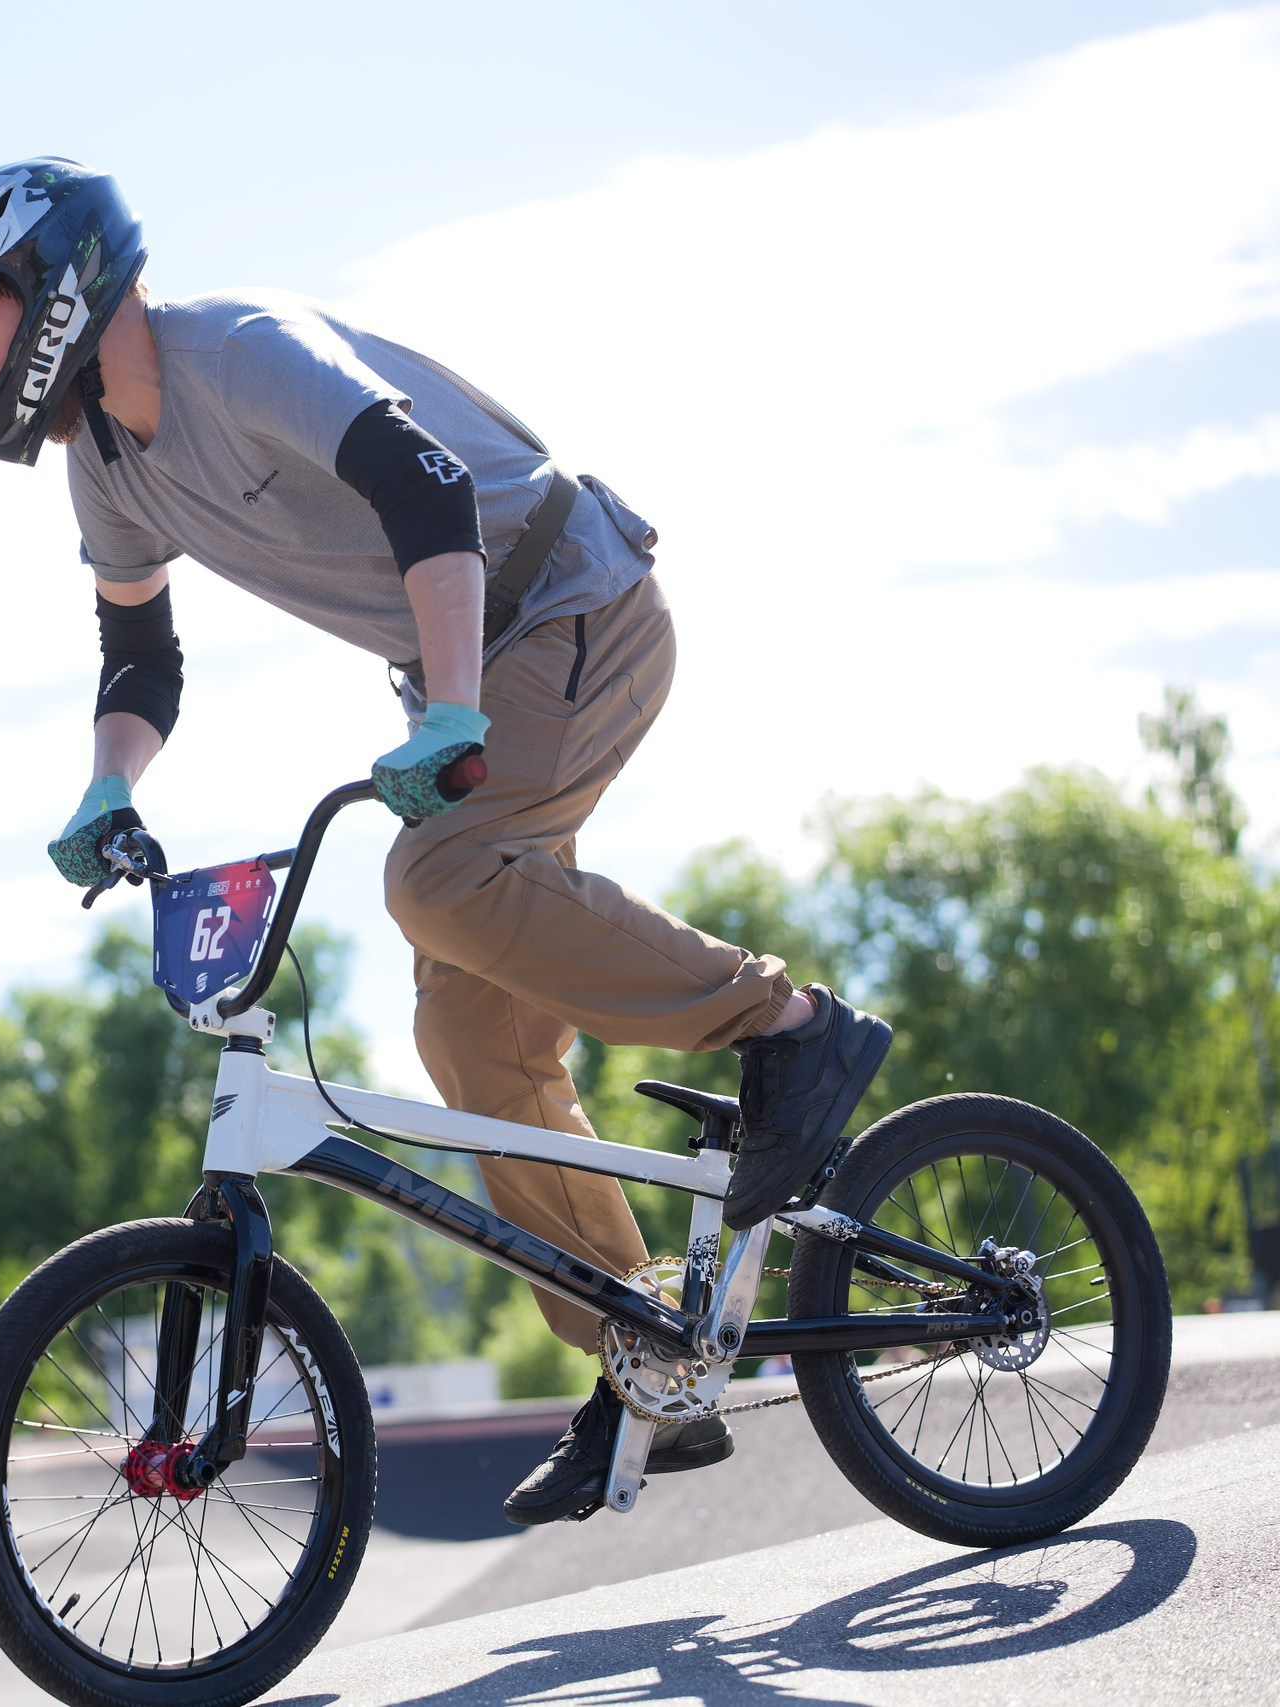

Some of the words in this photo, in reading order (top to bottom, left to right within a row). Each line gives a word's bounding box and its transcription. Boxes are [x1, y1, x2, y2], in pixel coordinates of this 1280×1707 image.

[19, 294, 77, 409] GIRO
[189, 905, 232, 962] 62
[376, 1163, 606, 1297] MEYBO
[327, 1525, 350, 1580] MAXXIS
